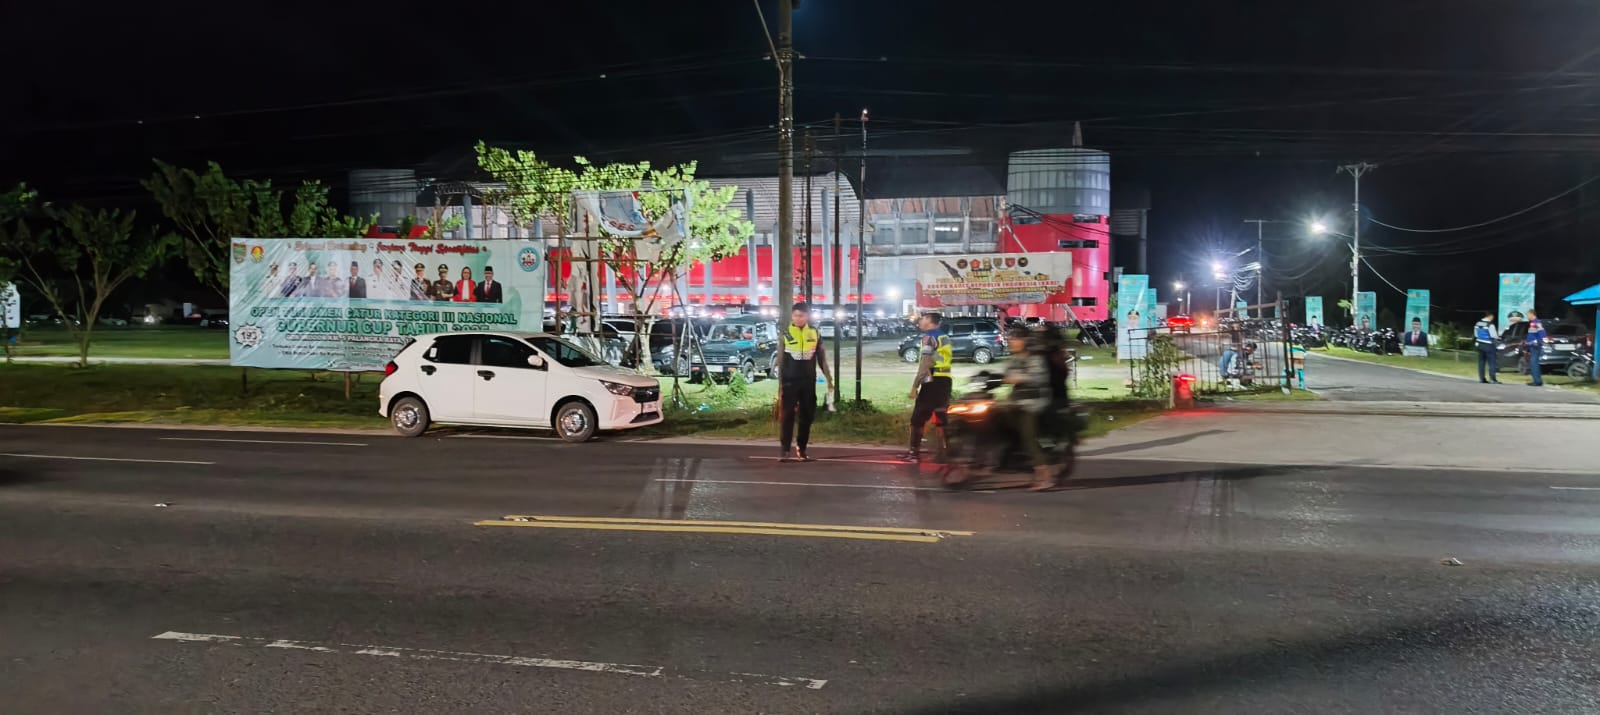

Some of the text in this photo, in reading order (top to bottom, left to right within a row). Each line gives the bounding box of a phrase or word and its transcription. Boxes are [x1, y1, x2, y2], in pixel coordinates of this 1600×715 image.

[345, 307, 383, 319] CATUR
[384, 309, 439, 322] KATEGORI
[441, 311, 455, 323] III
[457, 312, 518, 324] NASIONAL
[276, 319, 358, 333] GUBERNUR
[360, 320, 393, 335] CUP
[396, 322, 448, 336] TAHUN
